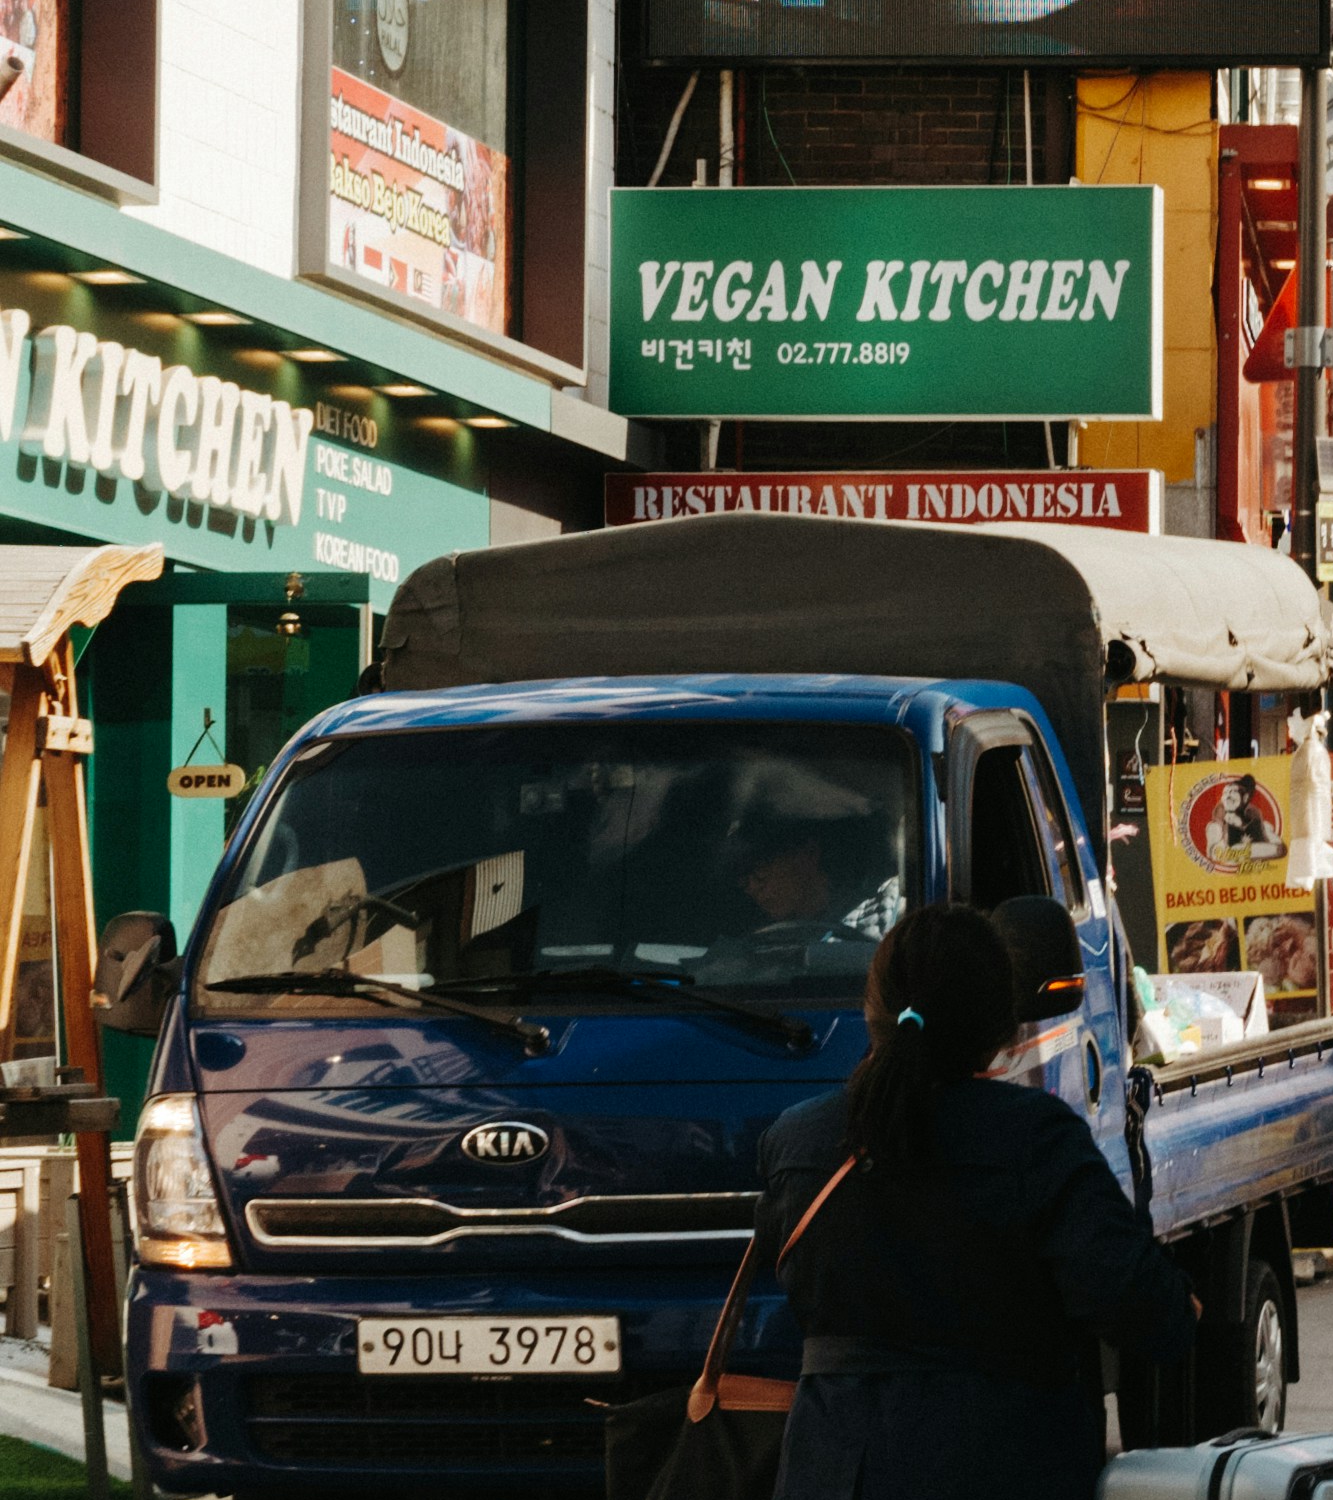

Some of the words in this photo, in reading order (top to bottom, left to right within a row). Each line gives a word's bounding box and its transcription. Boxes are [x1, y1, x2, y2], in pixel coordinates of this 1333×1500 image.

[331, 92, 393, 155] staurant
[394, 119, 464, 191] Indonesia
[372, 168, 405, 235] Bejo
[406, 190, 451, 248] Korea
[638, 260, 842, 322] VEGAN
[856, 259, 1130, 322] KITCHEN
[641, 338, 751, 370] 비건키친
[777, 342, 910, 365] 02.777.8819
[44, 326, 314, 527] KITCHEN
[315, 402, 340, 437] DIET
[343, 407, 378, 449] FOOD
[315, 488, 346, 523] TVP
[633, 483, 894, 521] RESTAURANT
[906, 483, 1123, 519] INDONESIA
[315, 532, 365, 573] KOREAN
[366, 549, 399, 583] FOOD
[179, 775, 231, 788] OPEN
[1165, 889, 1215, 909] BAKSO
[1219, 885, 1257, 905] BEJO
[476, 1131, 535, 1157] KIA
[489, 1325, 596, 1366] 3978
